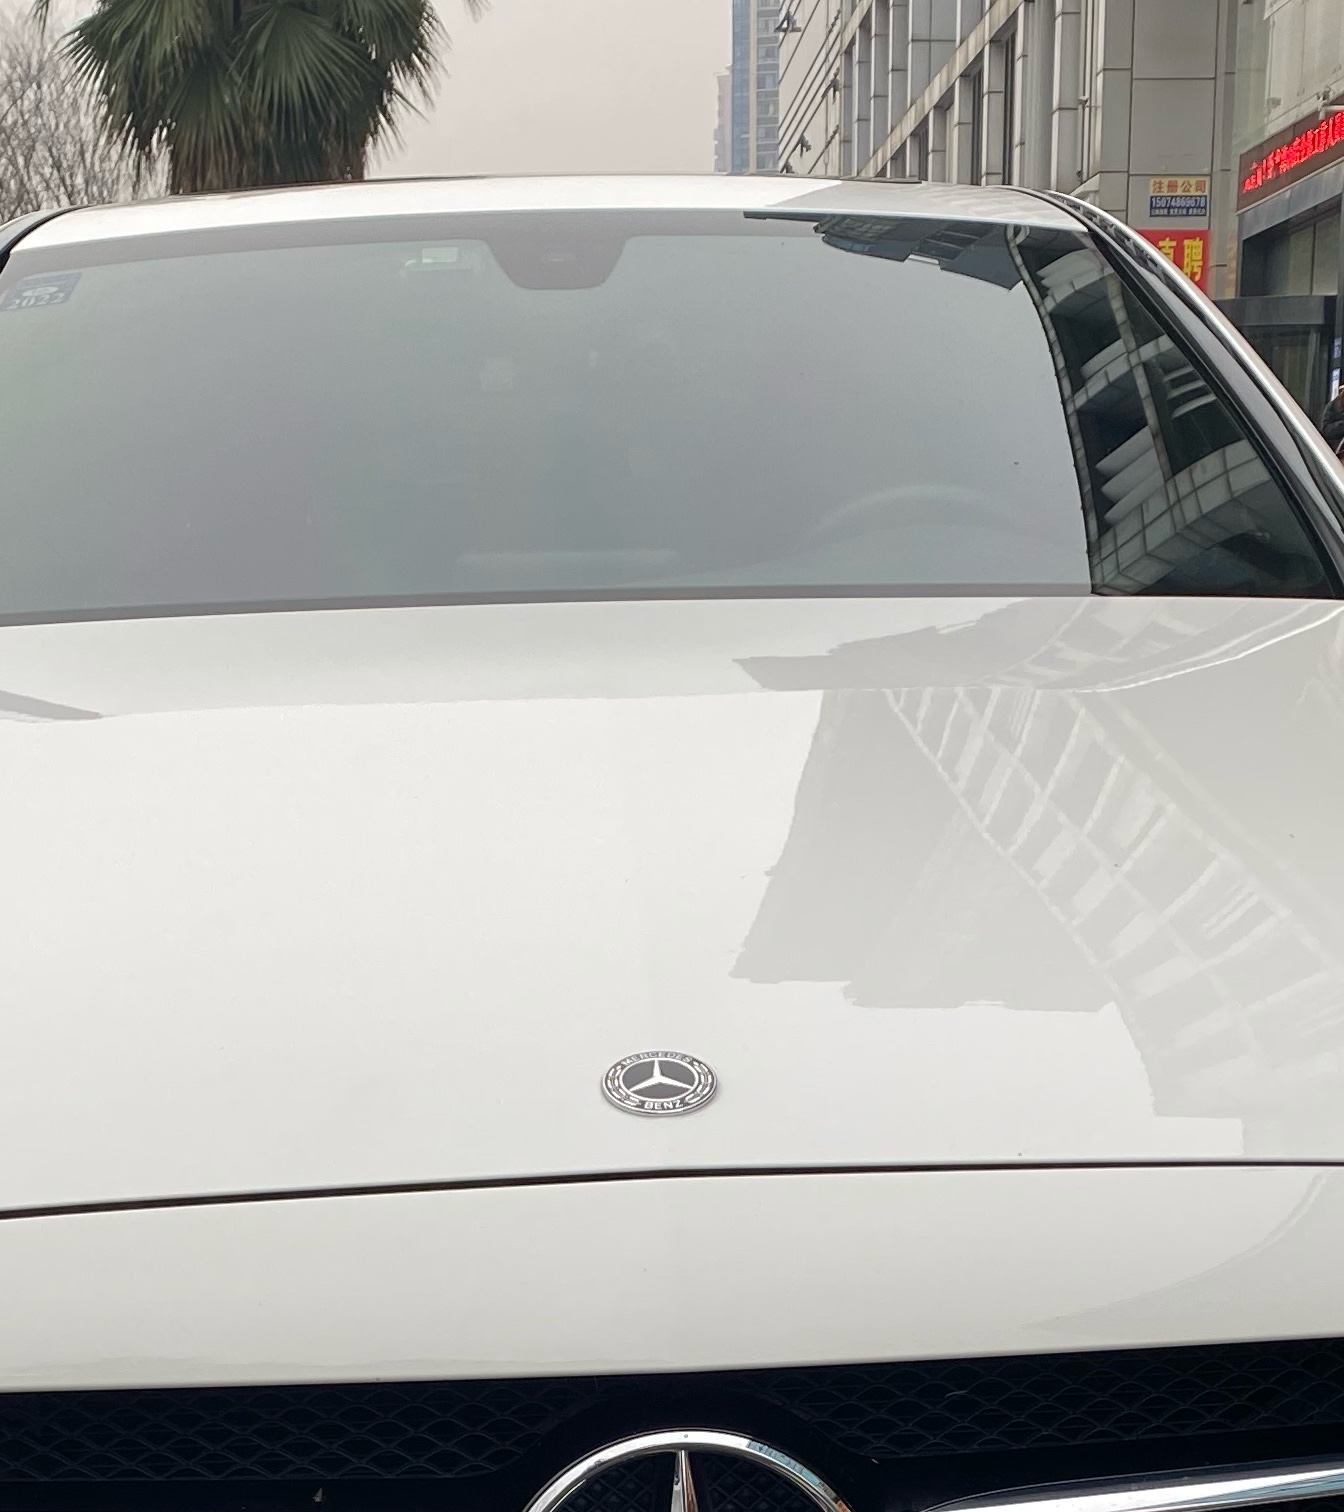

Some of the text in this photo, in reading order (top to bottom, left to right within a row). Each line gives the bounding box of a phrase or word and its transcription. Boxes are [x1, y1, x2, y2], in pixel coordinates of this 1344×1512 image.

[1152, 179, 1207, 194] 注册公司
[5, 291, 65, 310] 2022
[620, 1050, 693, 1066] MERCEDES
[644, 1100, 684, 1110] BENZ
